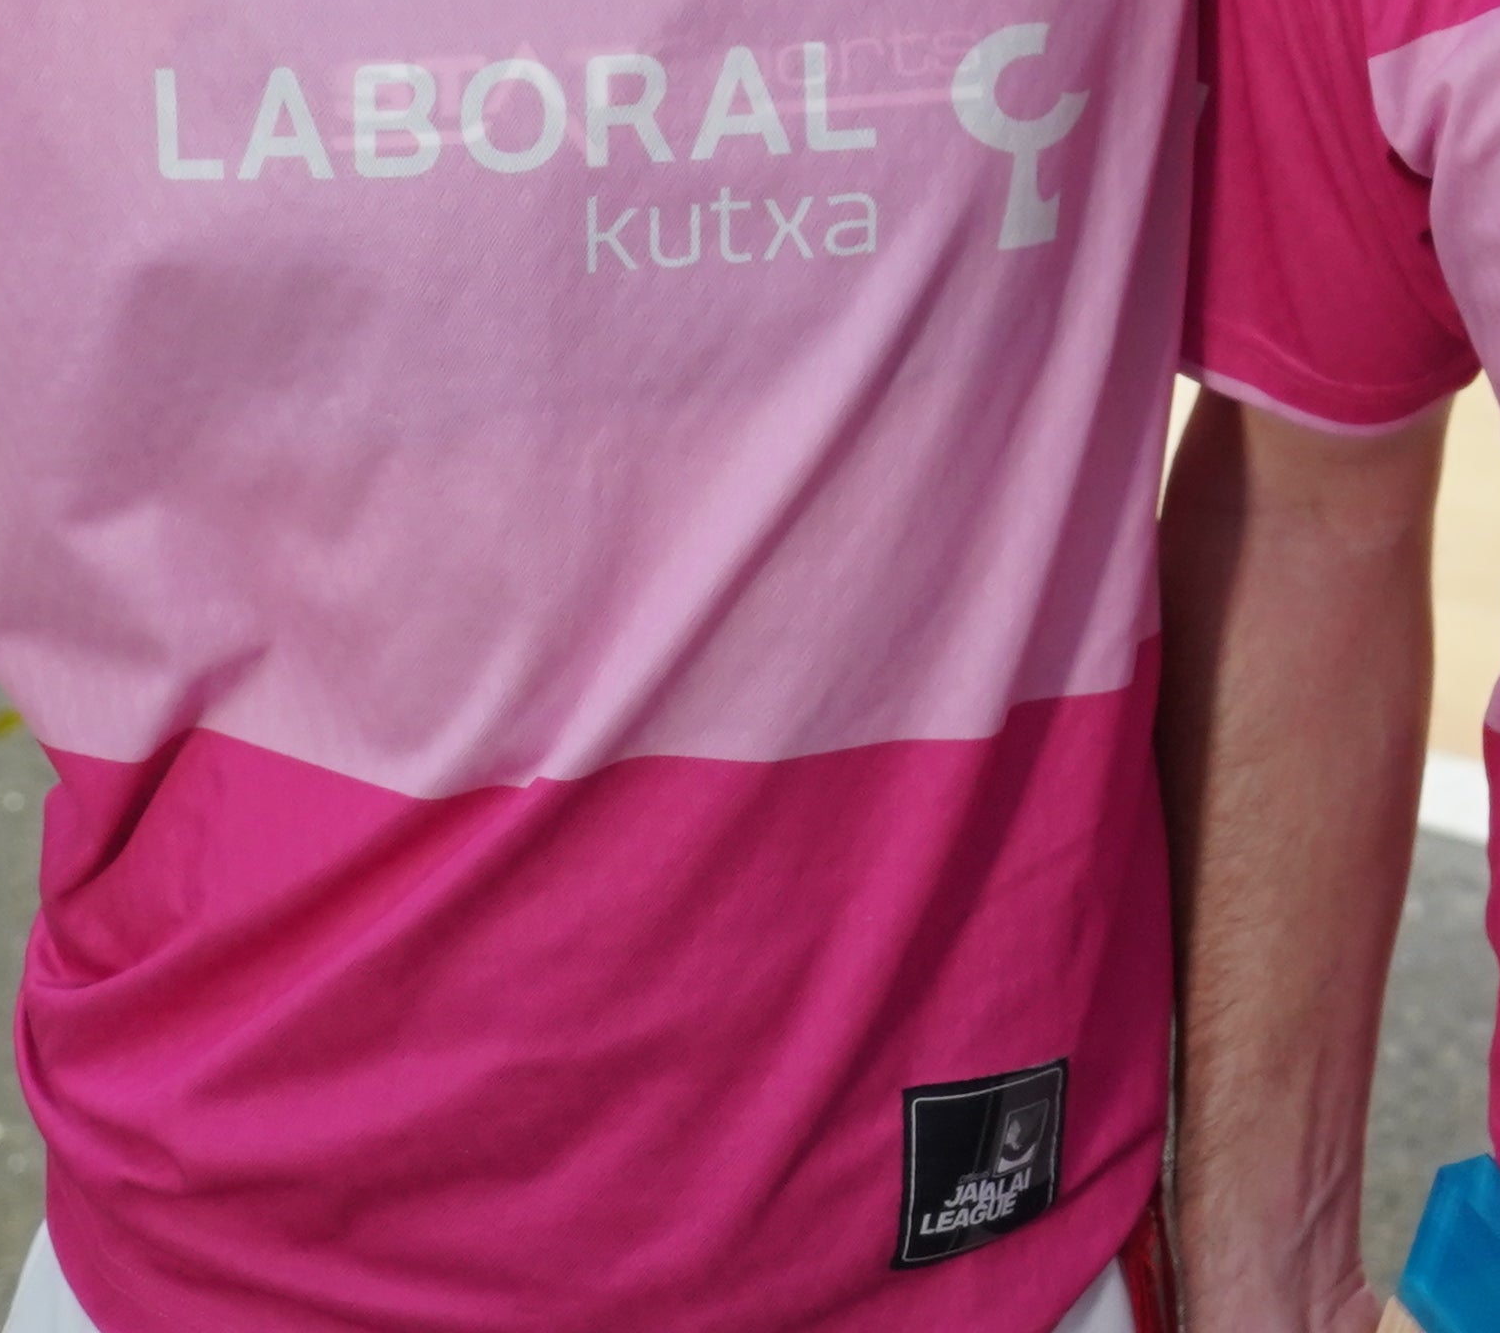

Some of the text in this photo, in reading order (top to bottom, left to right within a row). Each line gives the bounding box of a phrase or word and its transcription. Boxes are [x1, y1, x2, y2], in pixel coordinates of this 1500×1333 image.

[154, 41, 878, 181] LABORAL
[587, 185, 879, 274] kutxa
[919, 1191, 1017, 1235] LEAGUE
